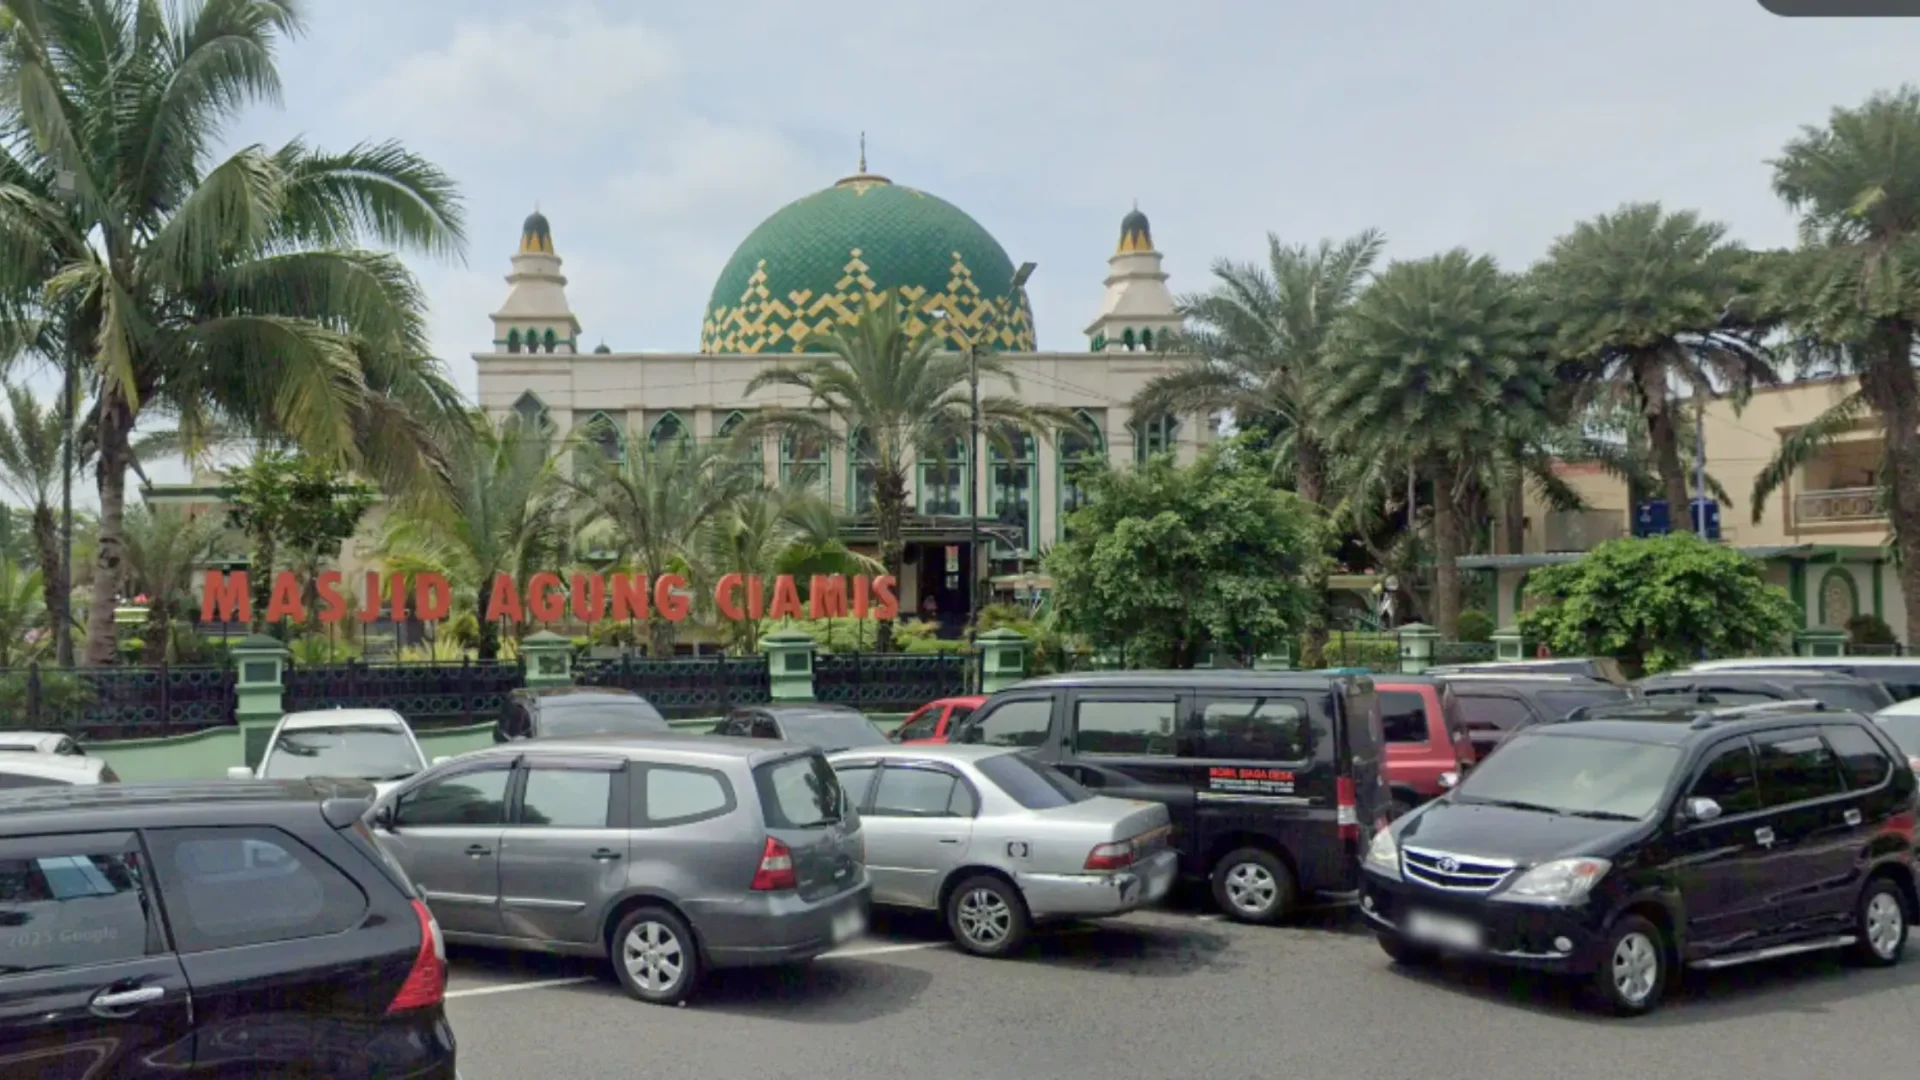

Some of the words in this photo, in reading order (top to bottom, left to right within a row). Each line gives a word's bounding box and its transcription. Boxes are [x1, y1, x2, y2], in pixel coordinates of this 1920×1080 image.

[201, 570, 452, 623] MASJID
[486, 572, 690, 623] AGUNG
[715, 573, 900, 620] CIAMIS
